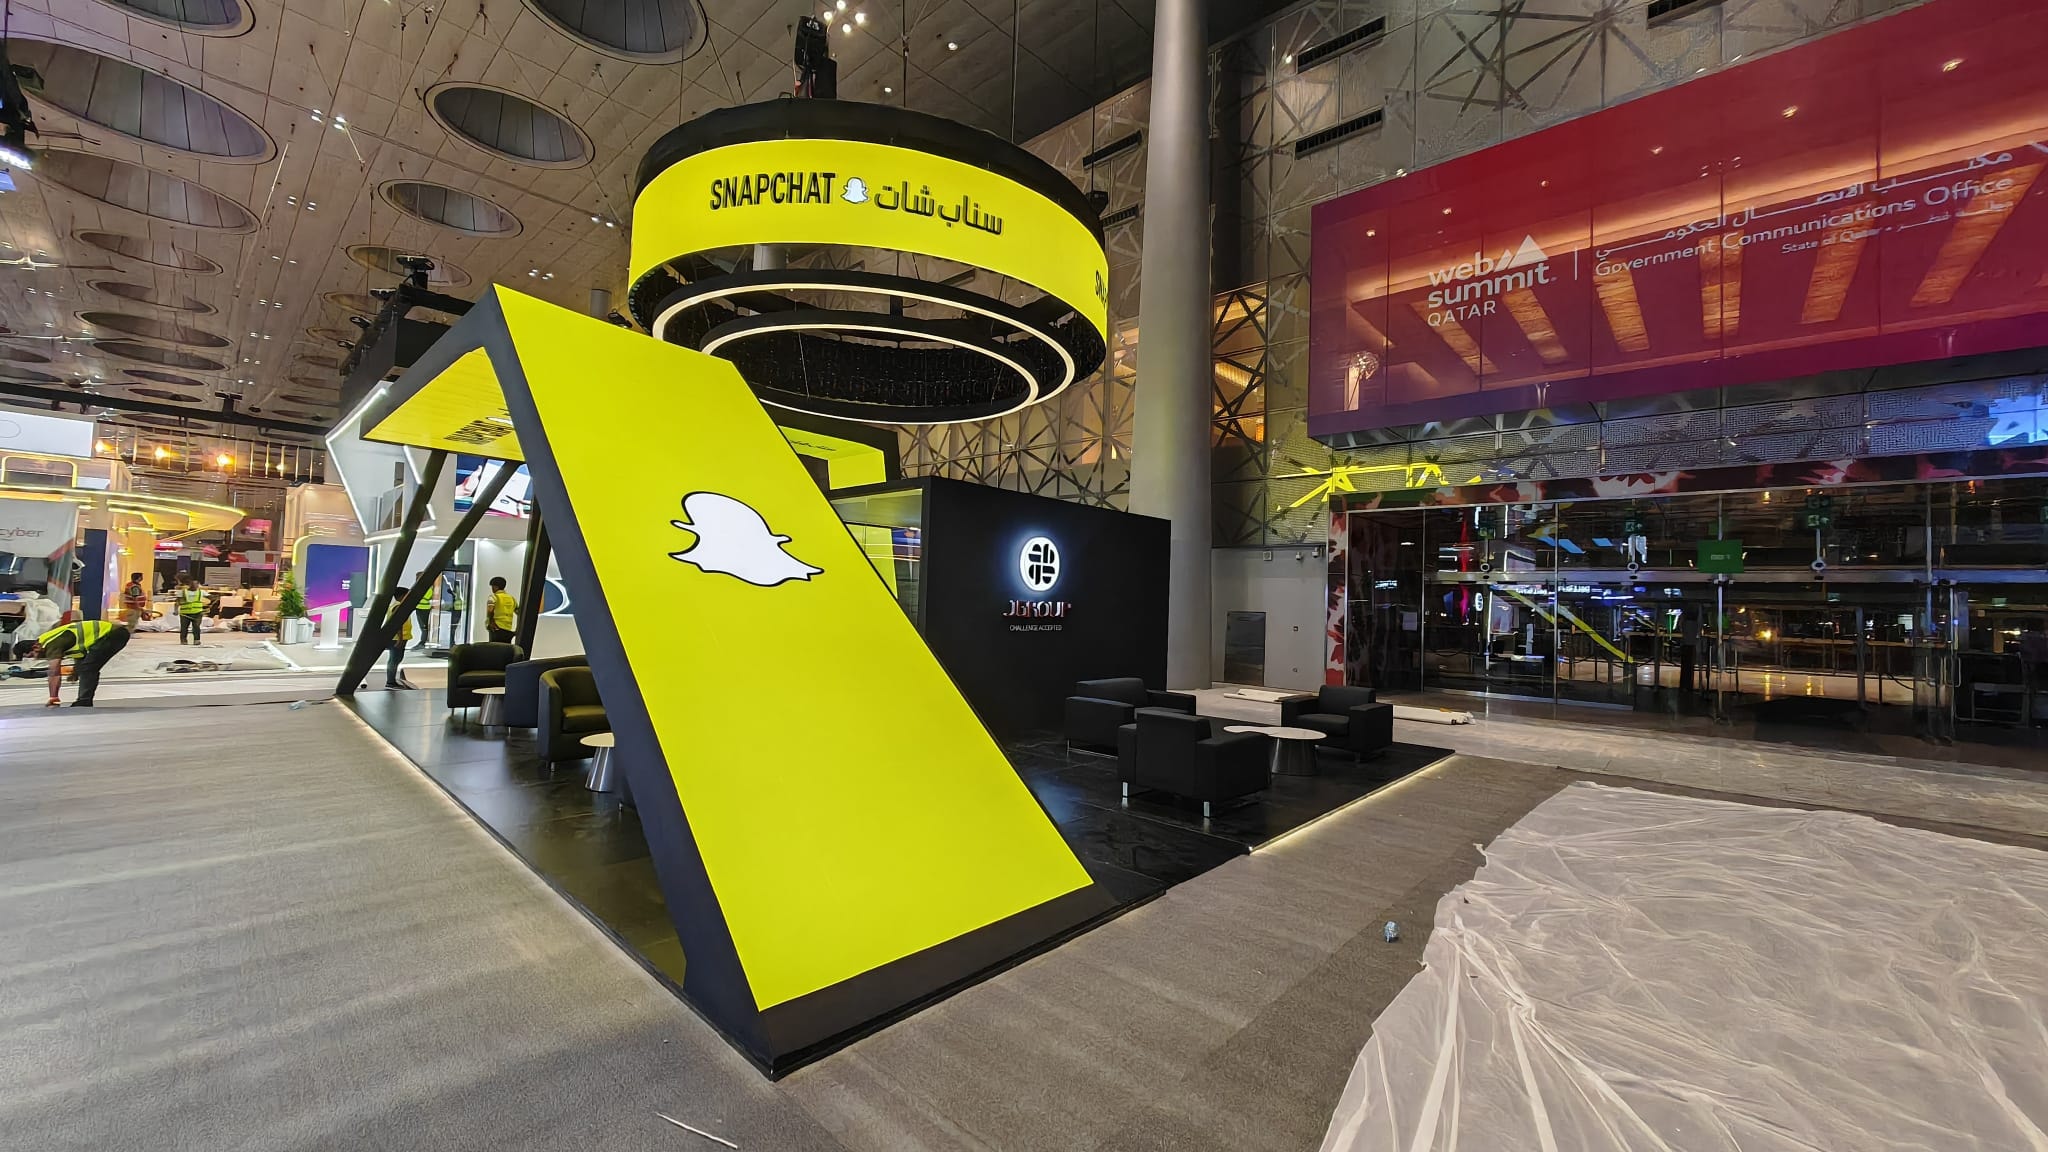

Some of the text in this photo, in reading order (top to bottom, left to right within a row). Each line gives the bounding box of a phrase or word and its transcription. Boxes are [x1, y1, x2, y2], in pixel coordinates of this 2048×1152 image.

[710, 172, 836, 210] SNAPCHAT
[874, 180, 1003, 235] سناب شات
[1595, 178, 2015, 277] Government Communications Office
[1781, 240, 1818, 254] State
[1427, 262, 1550, 309] summit
[1428, 251, 1495, 288] web
[1427, 300, 1497, 328] QATAR
